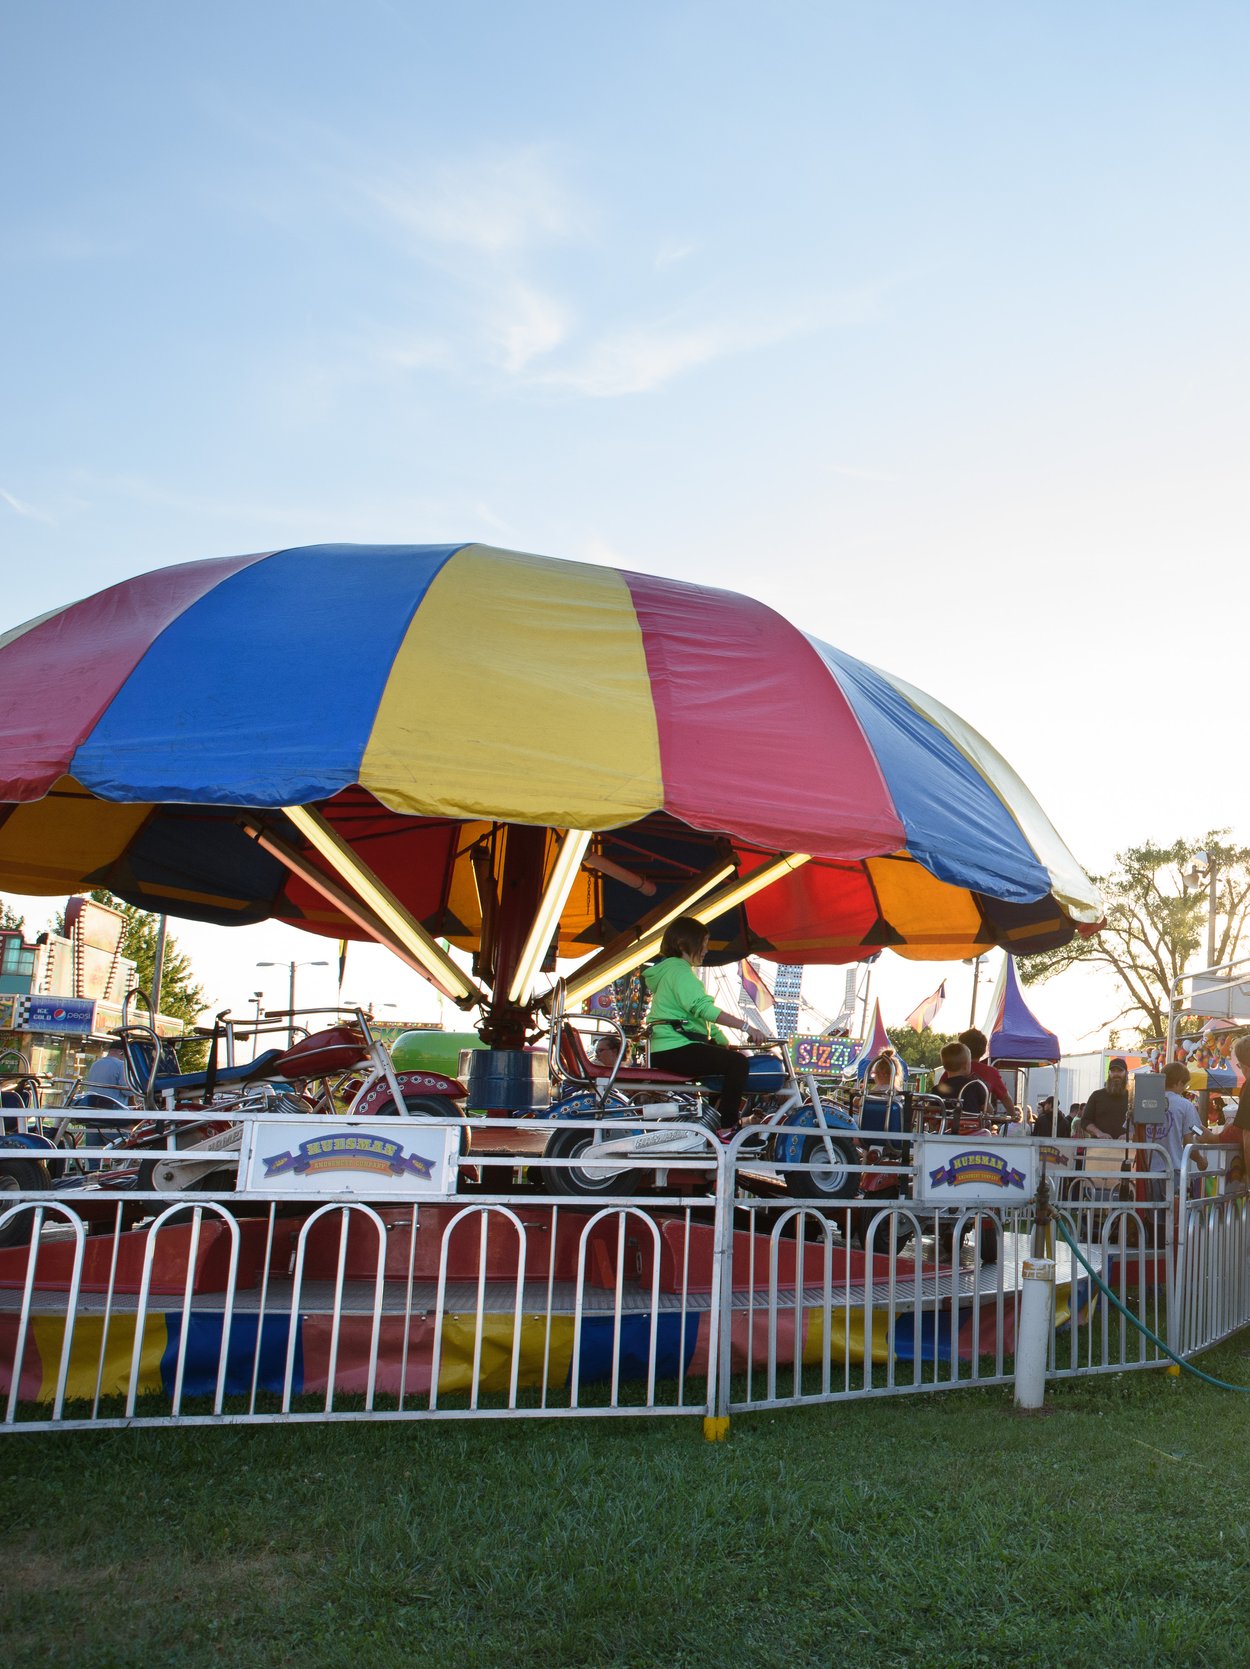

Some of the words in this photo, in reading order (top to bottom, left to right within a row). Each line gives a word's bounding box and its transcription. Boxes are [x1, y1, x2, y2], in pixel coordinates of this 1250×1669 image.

[66, 1012, 91, 1021] pepsi
[306, 1138, 397, 1156] HUESMAN
[953, 1155, 1004, 1170] HUESMAN
